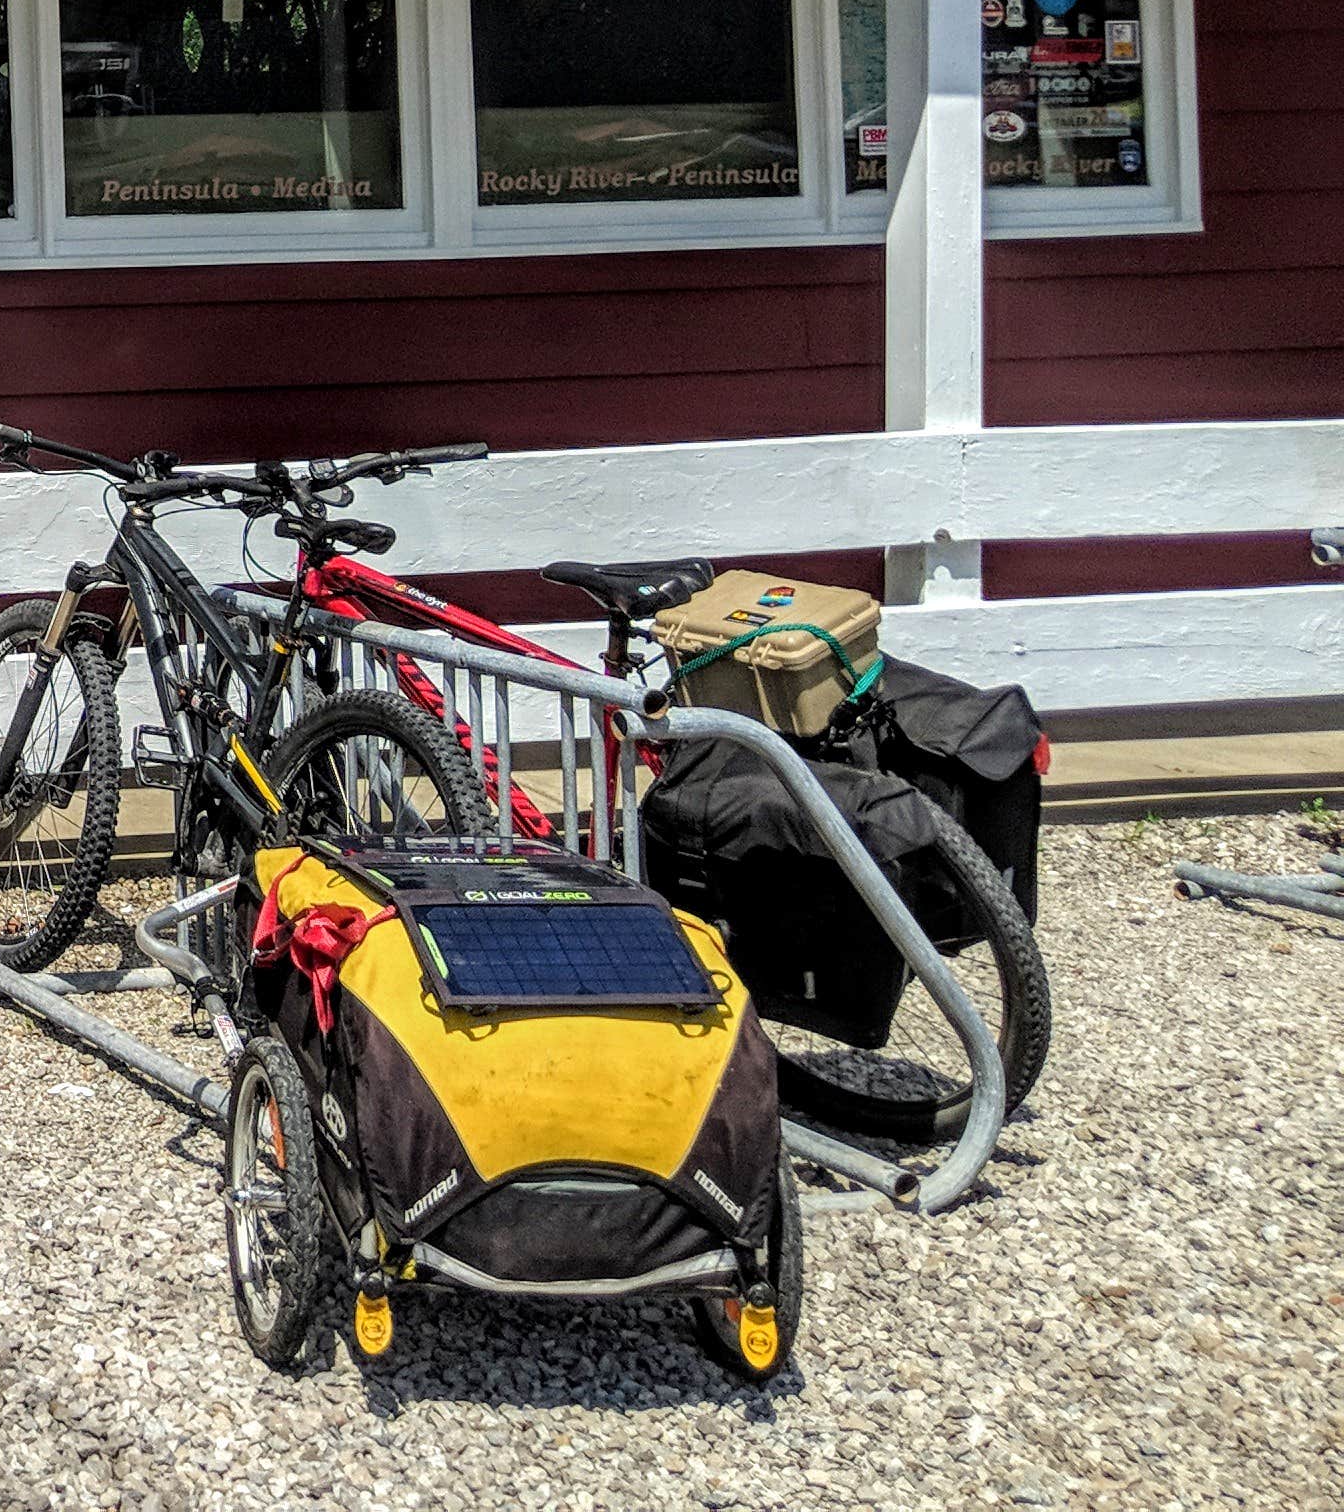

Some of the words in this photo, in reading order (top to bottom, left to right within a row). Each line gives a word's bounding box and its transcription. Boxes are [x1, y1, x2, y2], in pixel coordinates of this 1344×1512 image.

[480, 168, 561, 195] Rocky
[568, 166, 636, 189] River
[667, 163, 798, 186] Peninsula
[985, 153, 1043, 180] ocky
[100, 177, 239, 202] Peninsula
[272, 175, 373, 199] Medina
[404, 1168, 459, 1223] nomad
[693, 1168, 744, 1223] nomad
